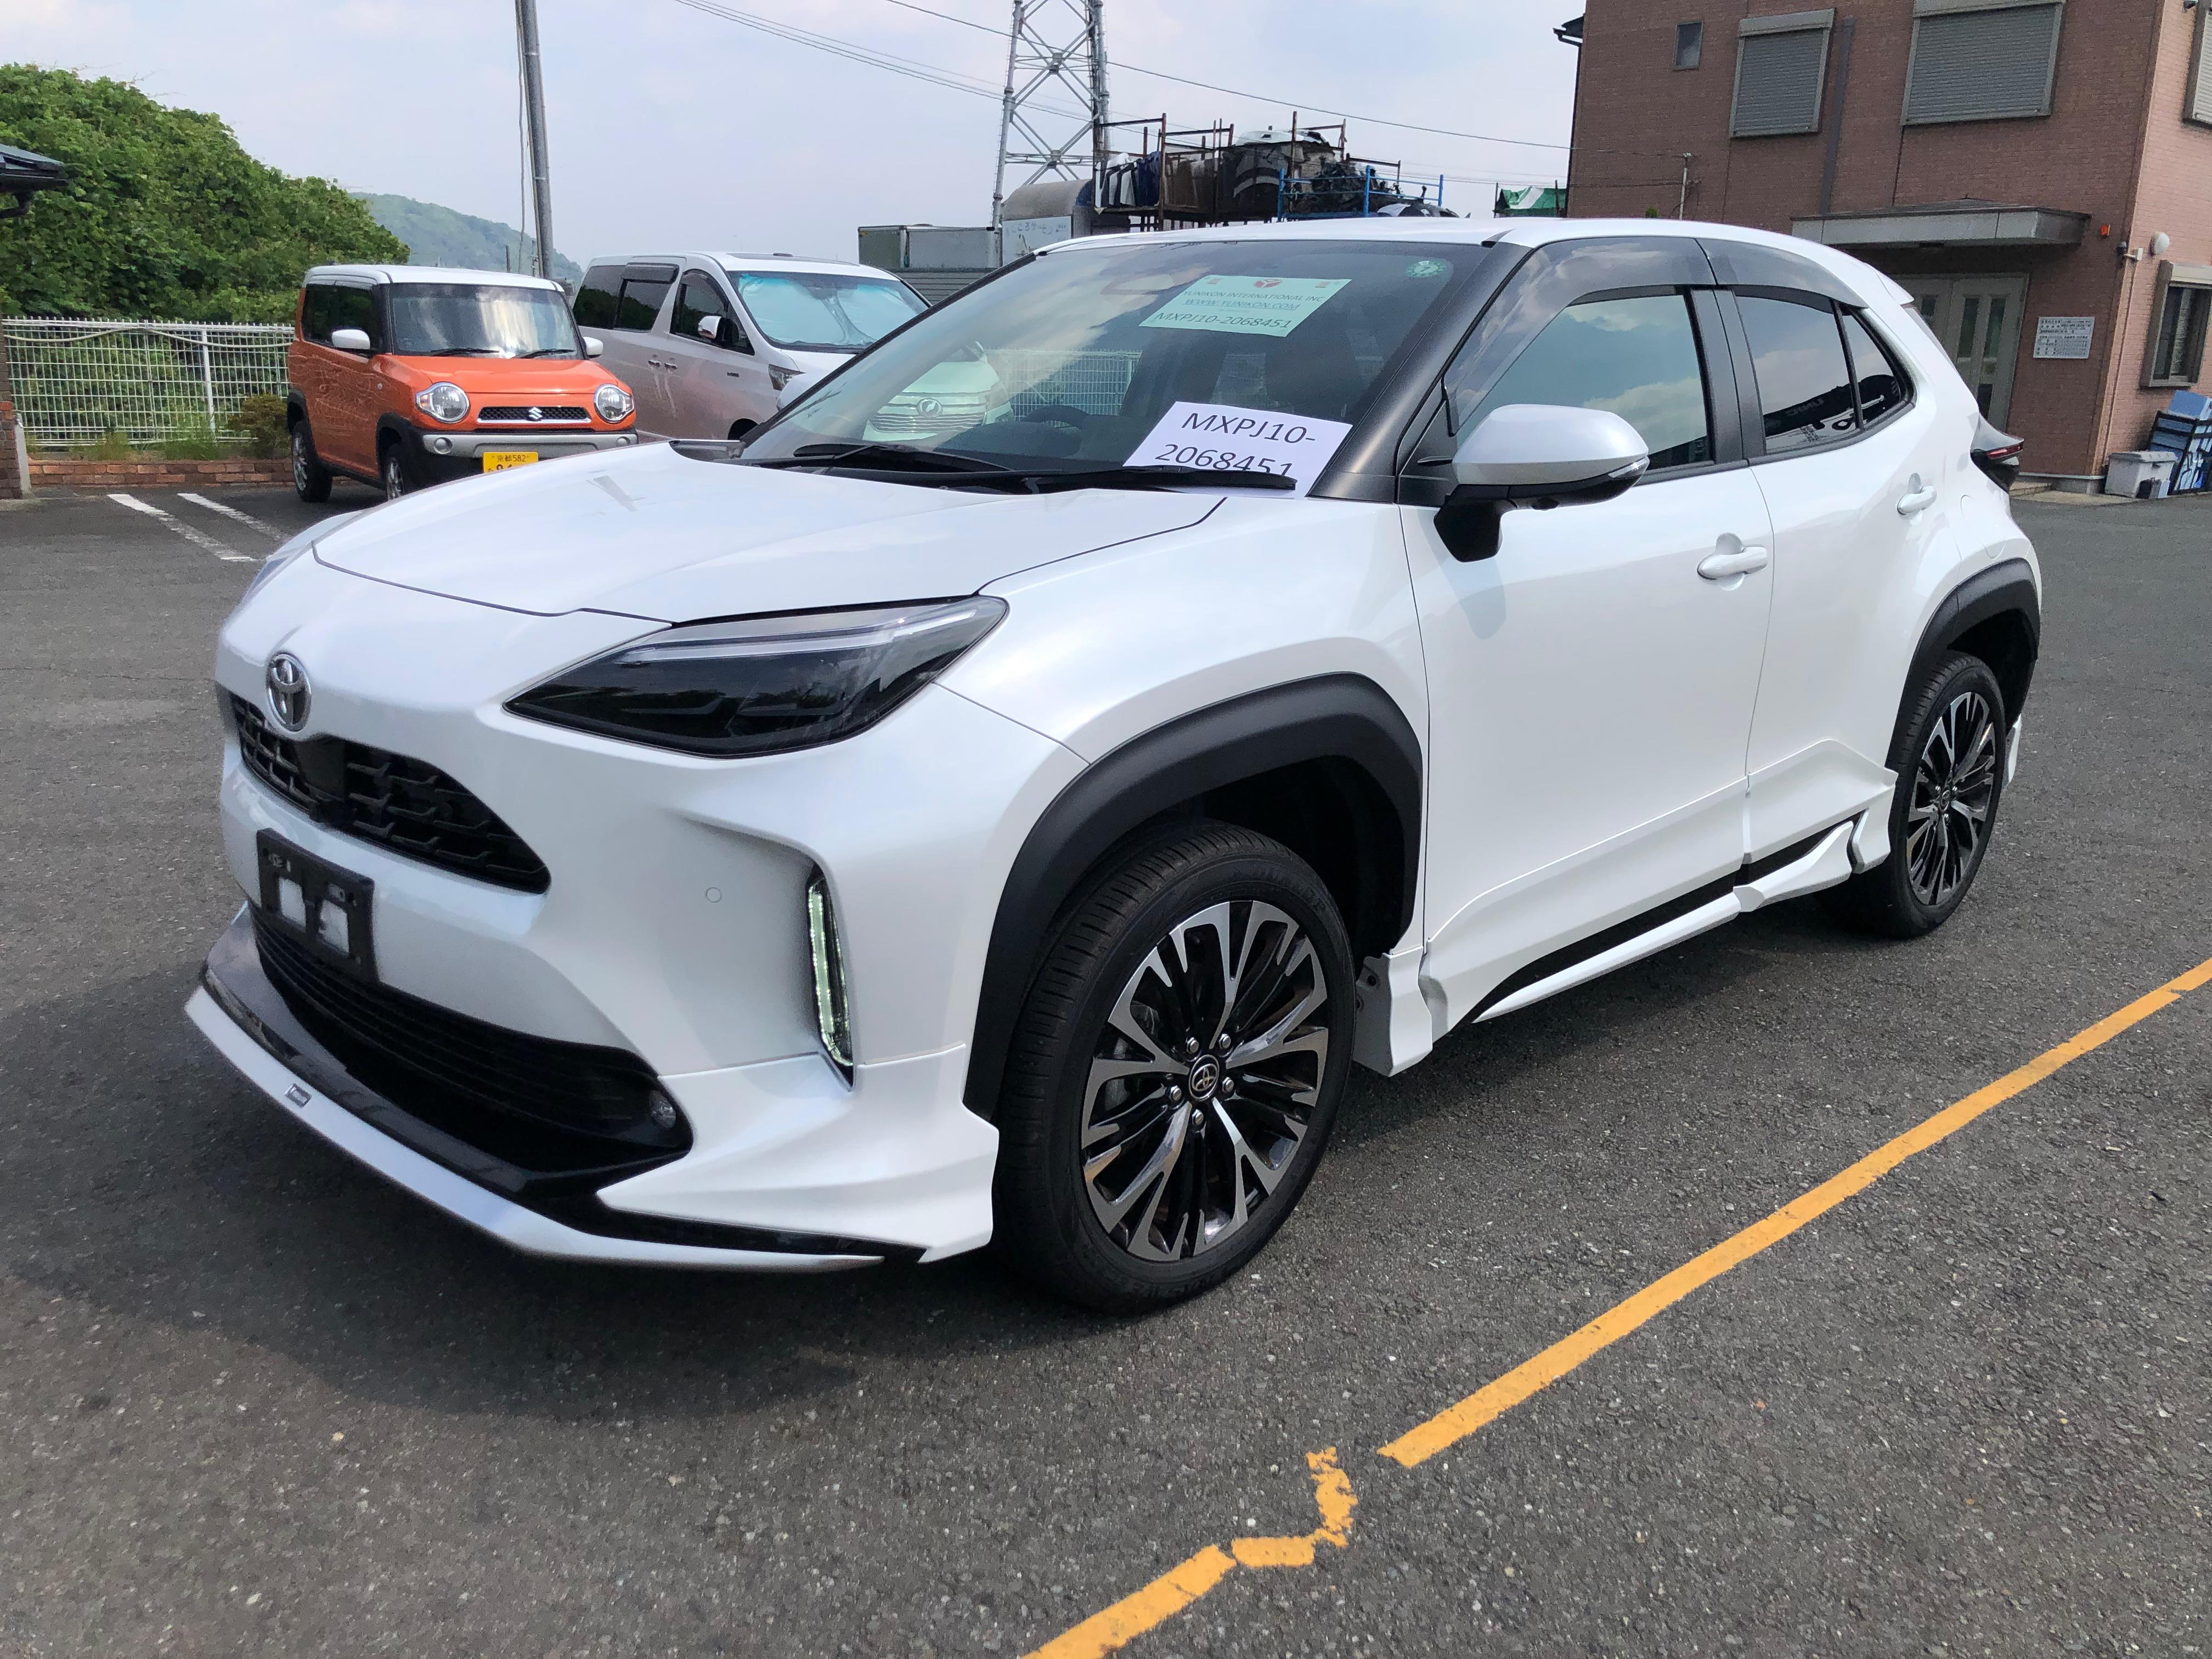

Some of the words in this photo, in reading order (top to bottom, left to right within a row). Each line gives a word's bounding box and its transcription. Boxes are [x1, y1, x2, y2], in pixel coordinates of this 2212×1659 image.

[1226, 292, 1304, 301] INTERNATIONAL
[1154, 312, 1293, 329] MXPJ10-2068451
[1181, 413, 1316, 444] MXPJ10-
[1154, 443, 1293, 476] 2068451
